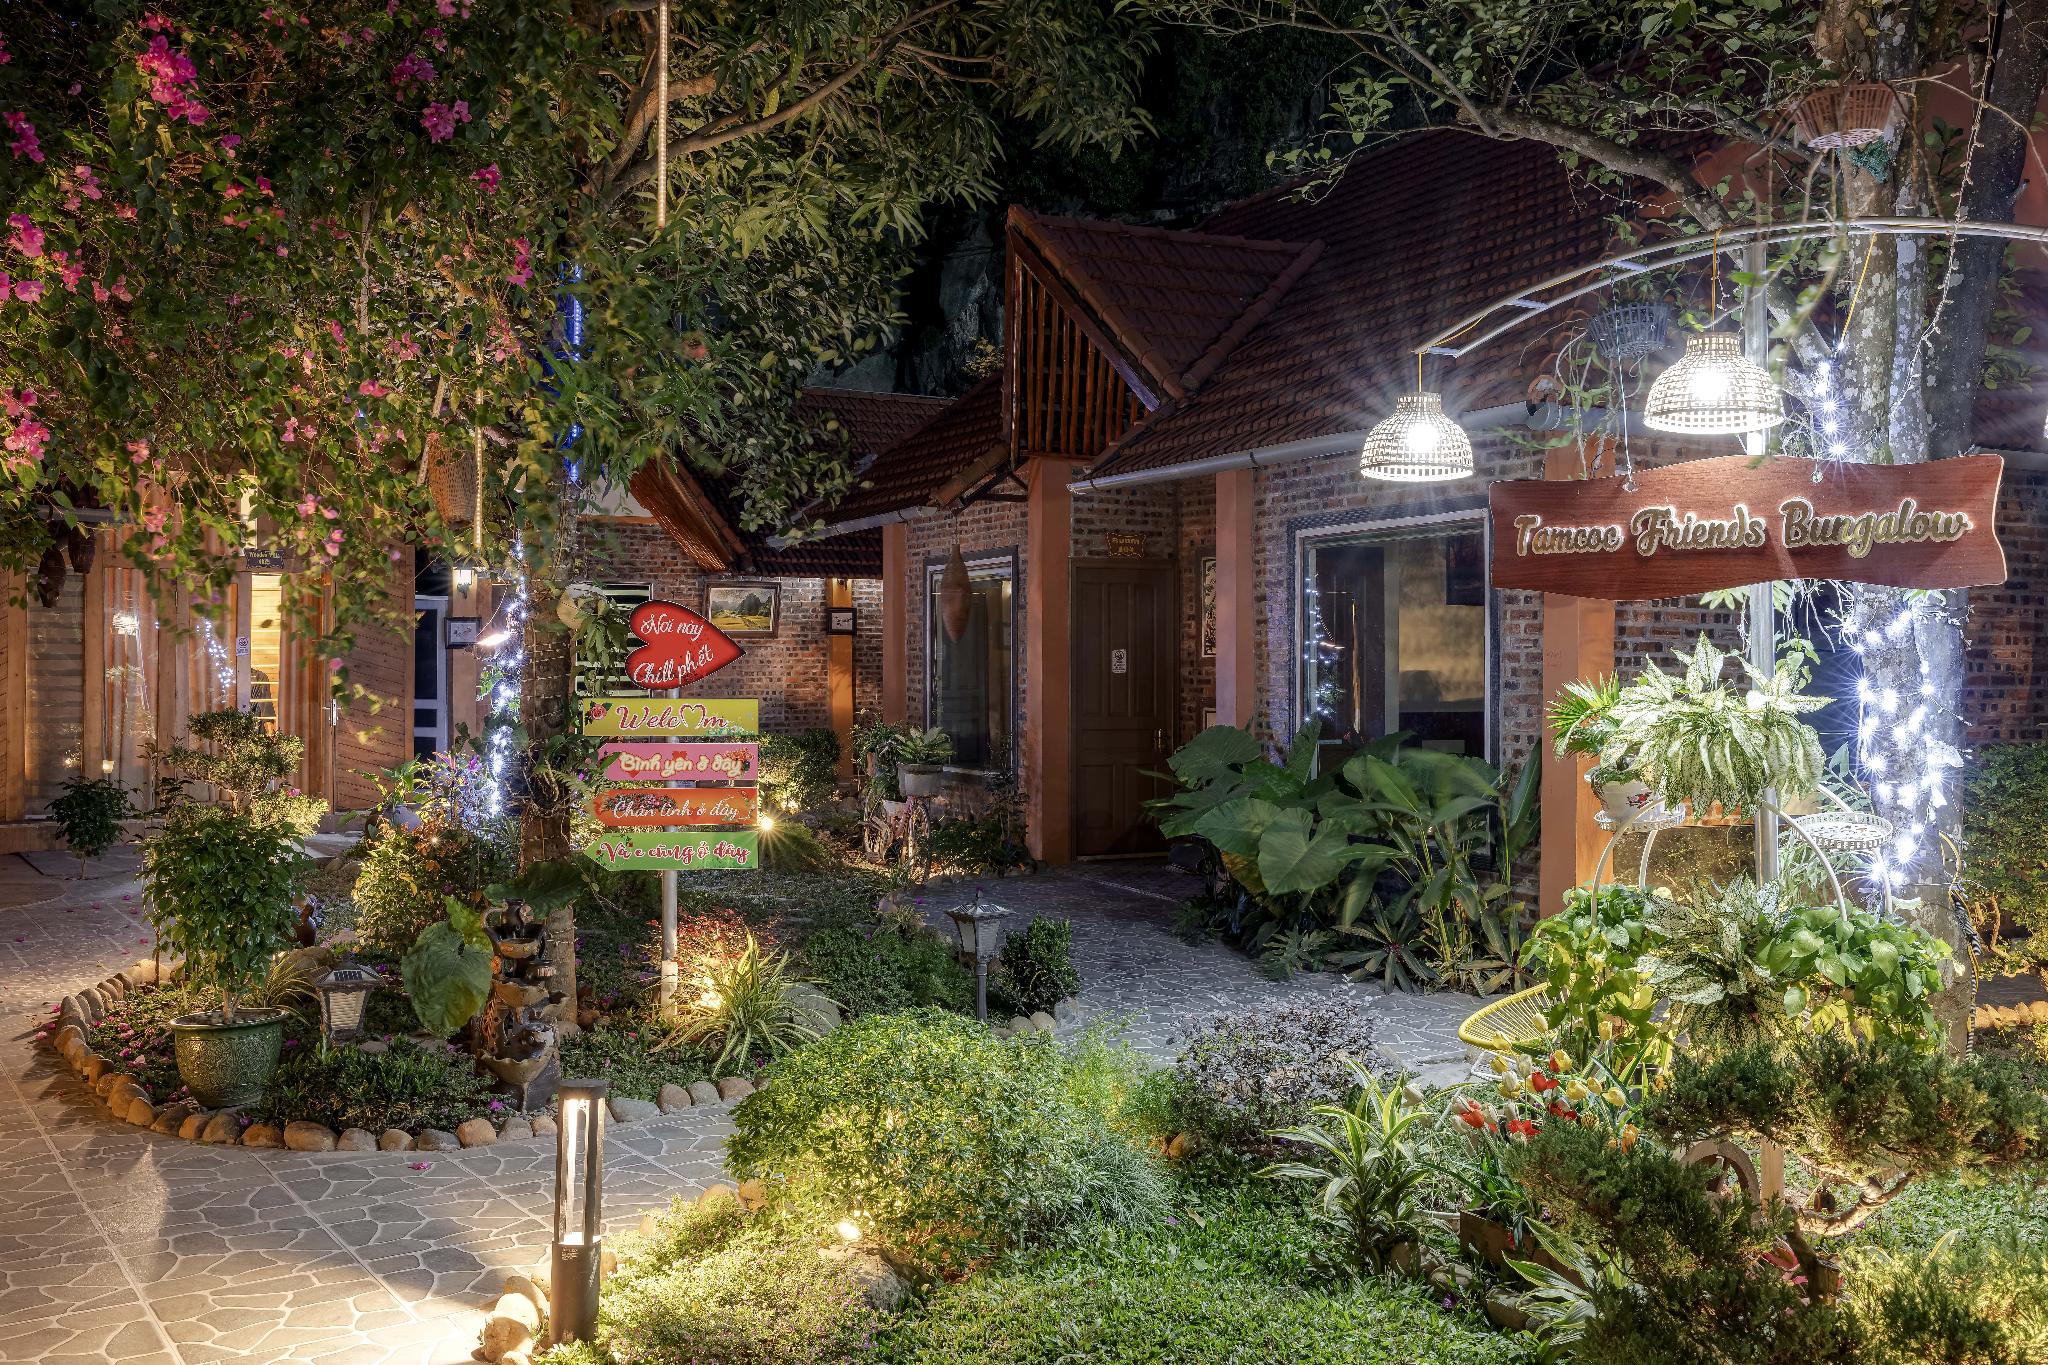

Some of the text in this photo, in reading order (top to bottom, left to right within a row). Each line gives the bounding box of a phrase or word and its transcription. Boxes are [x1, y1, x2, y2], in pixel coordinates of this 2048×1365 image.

[1514, 495, 1974, 559] Tamcoc Friends Bungalow
[633, 658, 675, 684] Chill
